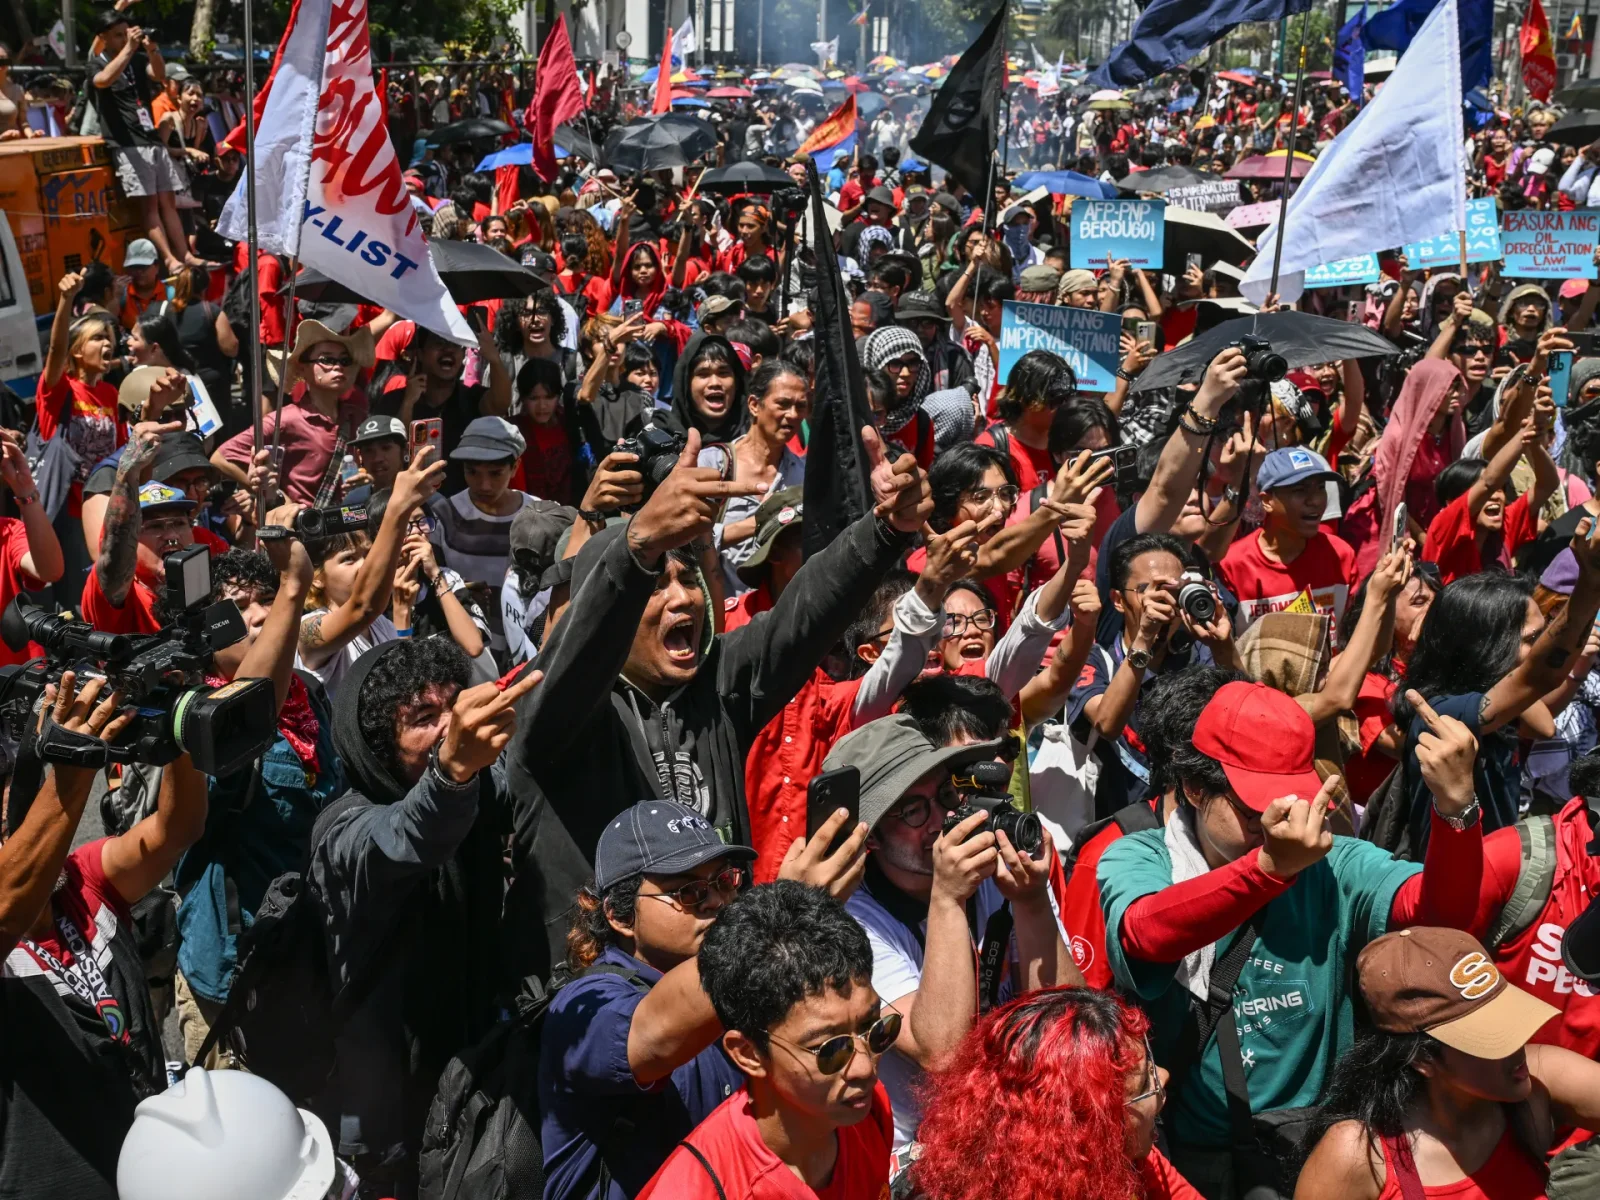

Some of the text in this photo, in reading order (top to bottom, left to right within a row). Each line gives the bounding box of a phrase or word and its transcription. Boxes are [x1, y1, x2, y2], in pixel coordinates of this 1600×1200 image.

[1182, 182, 1237, 197] IMPERIALISTS
[1083, 202, 1151, 222] AFP-PNP
[1079, 219, 1155, 241] BERDUGO!
[1568, 215, 1597, 231] ANG
[1534, 231, 1560, 244] OIL
[1504, 242, 1593, 256] DEREGULATION
[1014, 305, 1105, 330] BIGUIN ANG
[1001, 326, 1117, 354] IMPERYALISTANG
[1249, 599, 1294, 617] JEROM
[987, 940, 1000, 966] EOS
[1449, 951, 1500, 1000] S
